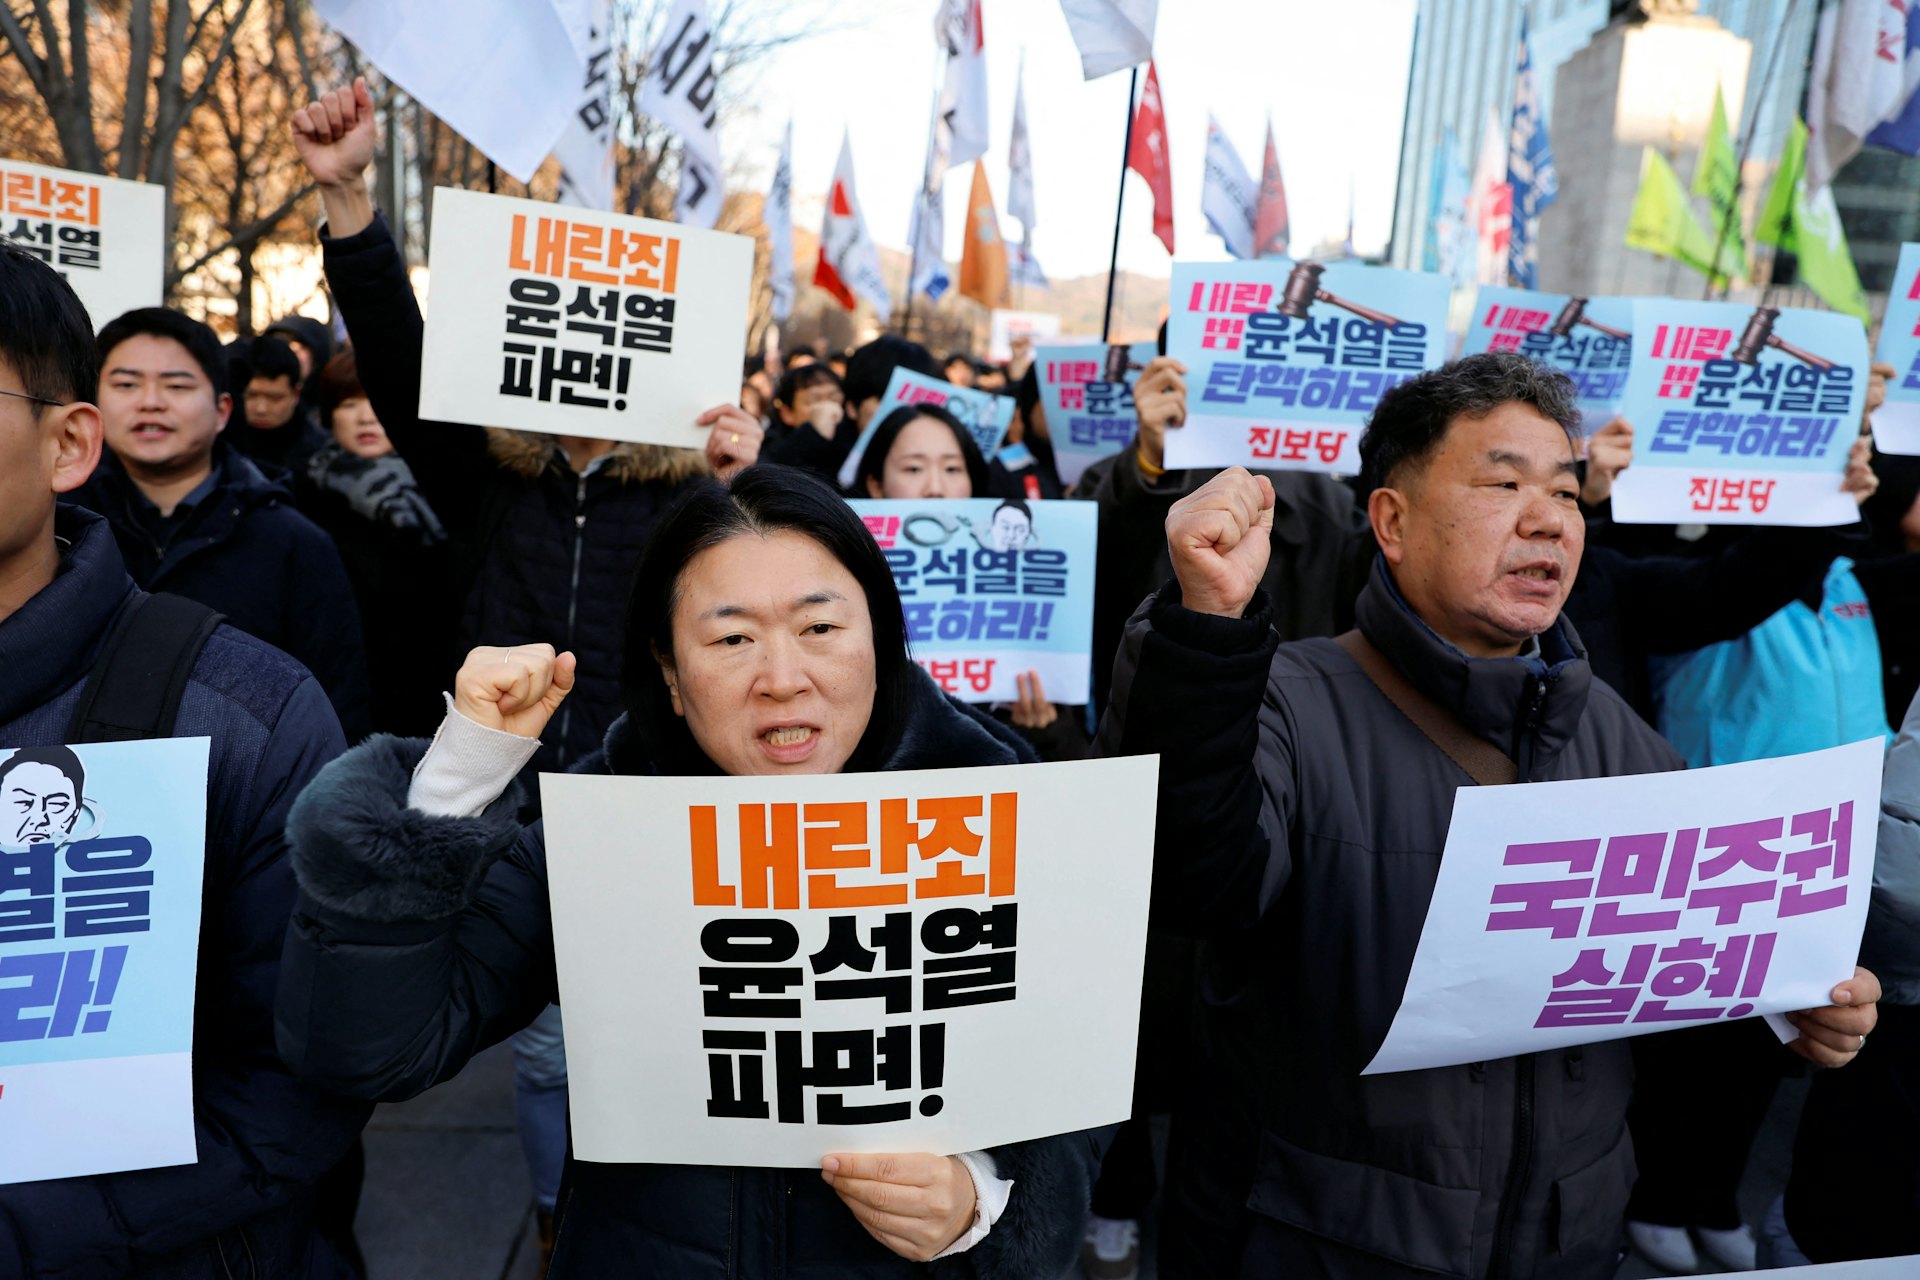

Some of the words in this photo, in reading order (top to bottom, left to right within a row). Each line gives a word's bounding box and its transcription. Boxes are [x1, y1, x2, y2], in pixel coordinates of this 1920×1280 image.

[0, 170, 101, 227] 란죄
[0, 218, 101, 270] 석열
[509, 214, 680, 294] 내란죄
[506, 278, 675, 353] 윤석열
[1188, 281, 1274, 315] 내란
[1244, 311, 1427, 370] 윤석열을
[1650, 325, 1732, 361] 내란
[500, 341, 631, 411] 파면!
[1202, 362, 1416, 413] 탄핵하라
[1694, 358, 1854, 414] 윤석열을
[1248, 426, 1347, 463] 진보당
[1650, 410, 1839, 457] 탄핵하라!
[1689, 478, 1776, 514] 진보당
[883, 548, 1068, 597] 윤석열을
[917, 659, 997, 693] 보당
[689, 792, 1018, 909] 내란죄
[1485, 800, 1854, 940] 국민주권
[698, 902, 1018, 1012] 윤석열
[1533, 932, 1778, 1029] 실현!
[702, 1022, 946, 1125] 파면!
